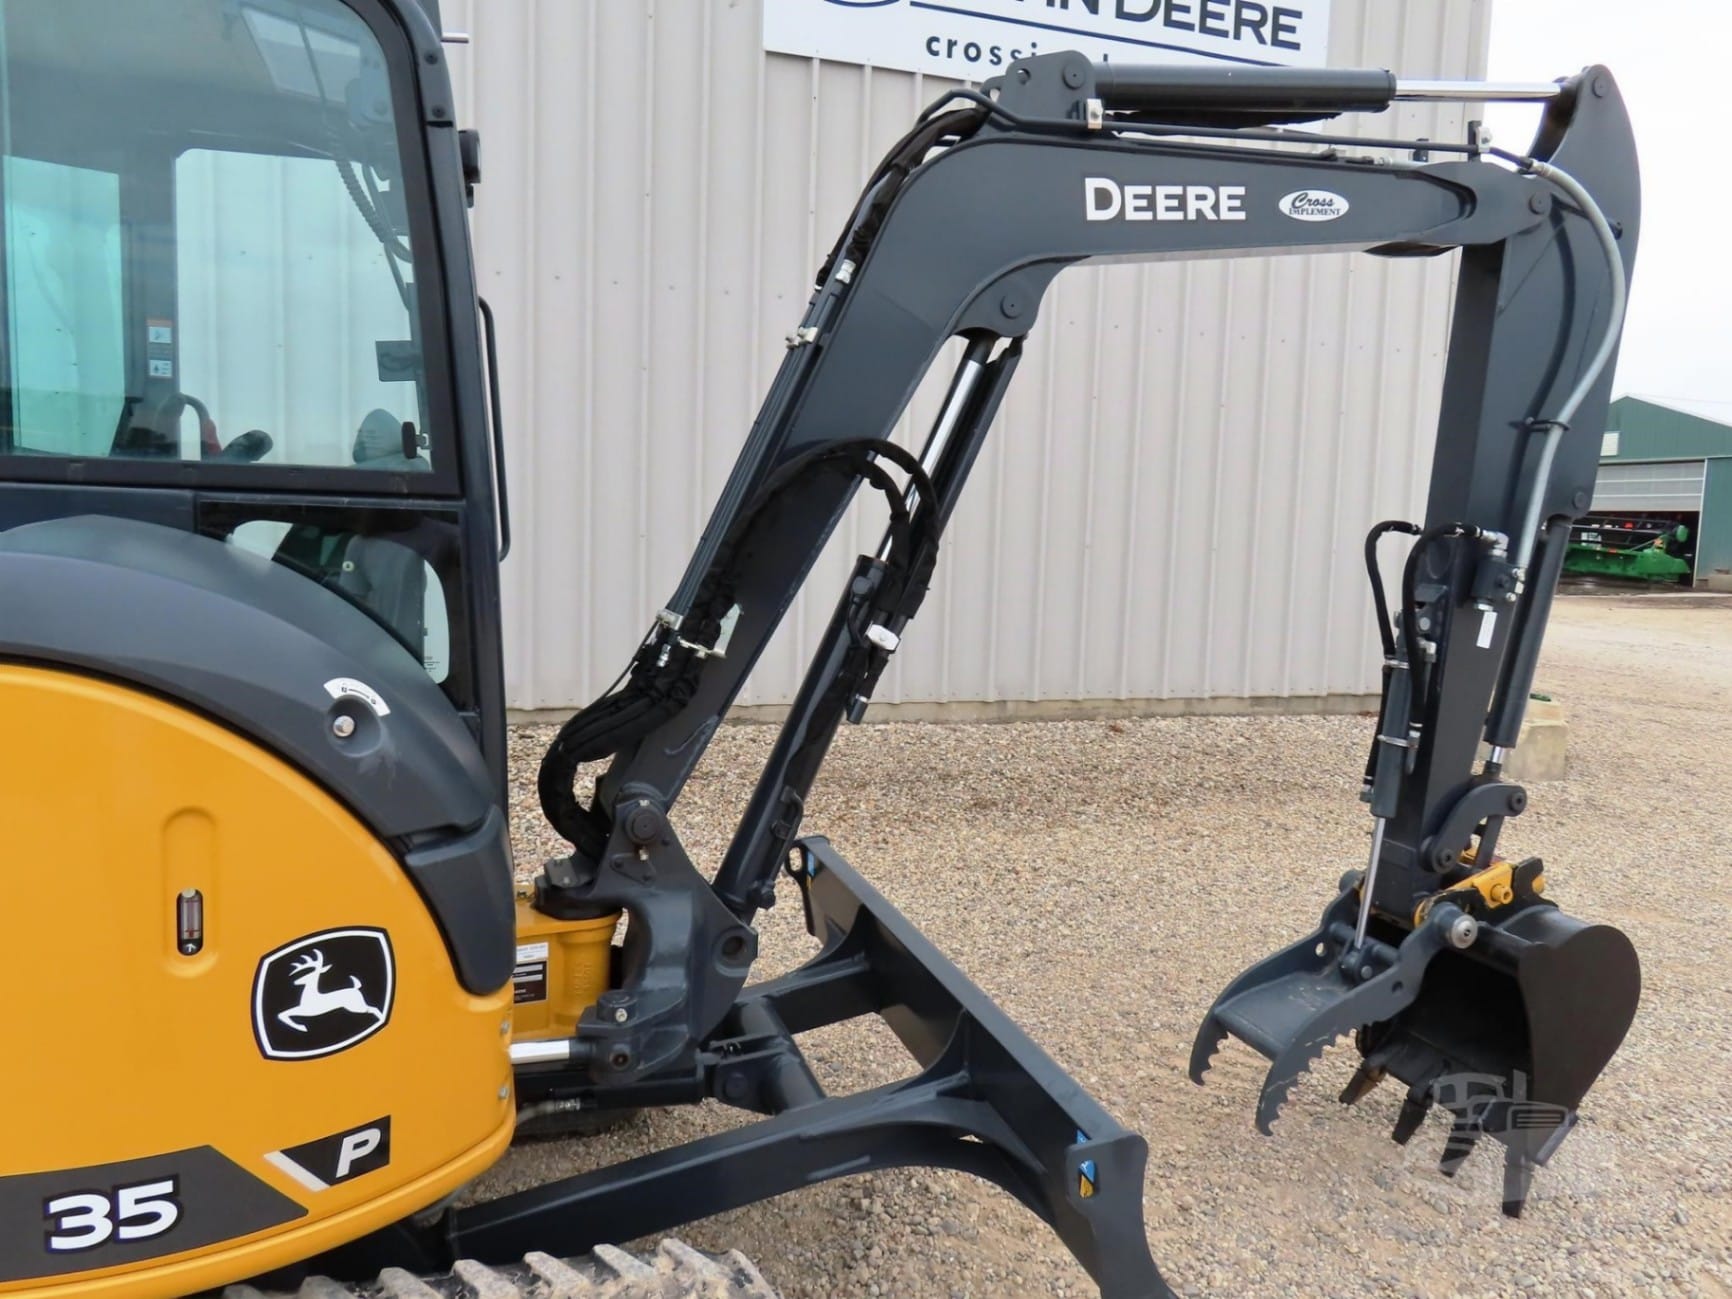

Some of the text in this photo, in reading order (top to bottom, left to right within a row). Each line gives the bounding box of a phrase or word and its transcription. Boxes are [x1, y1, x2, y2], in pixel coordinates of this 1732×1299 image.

[1084, 177, 1247, 221] DEERE
[1288, 207, 1342, 216] IMPLEMENT
[1291, 192, 1335, 209] Cross
[335, 1127, 382, 1179] P
[47, 1179, 179, 1251] 35
